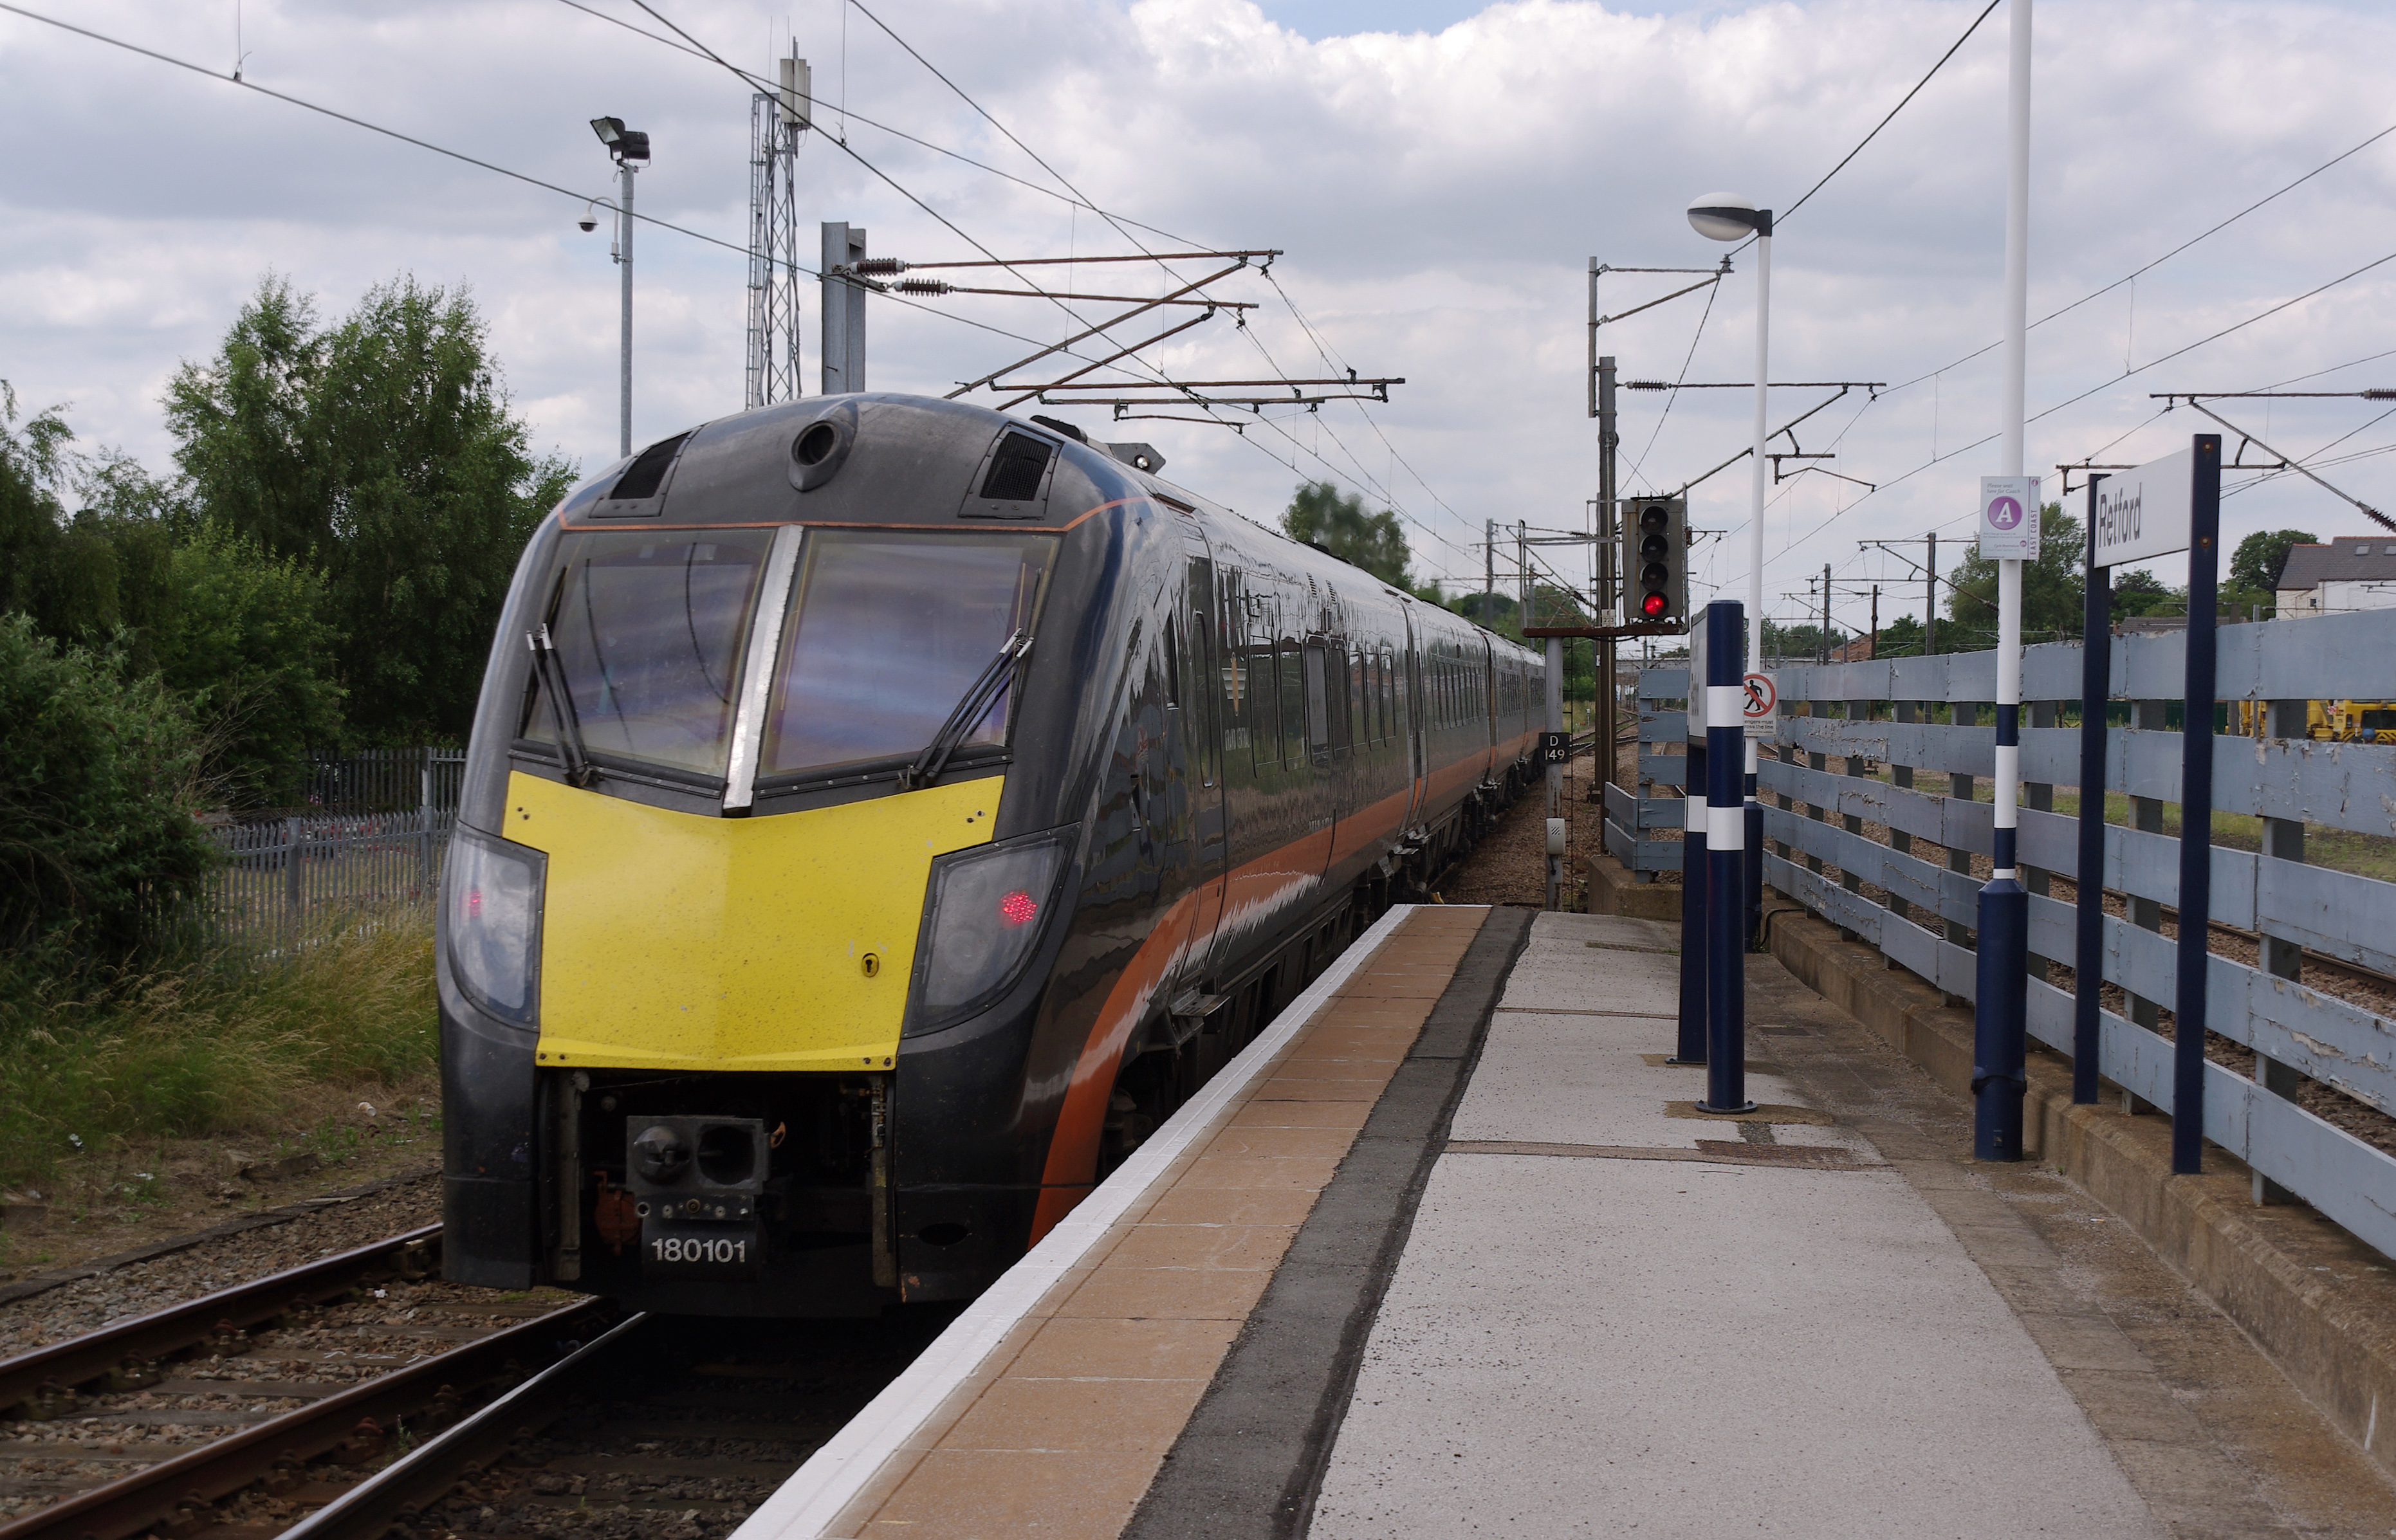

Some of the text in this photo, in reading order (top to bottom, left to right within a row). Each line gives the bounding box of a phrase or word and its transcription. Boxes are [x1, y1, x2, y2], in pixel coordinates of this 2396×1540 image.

[1995, 501, 2013, 523] A
[2099, 482, 2141, 548] Retford
[1550, 735, 1558, 746] D
[1545, 749, 1565, 760] 149
[652, 1238, 745, 1263] 180101
